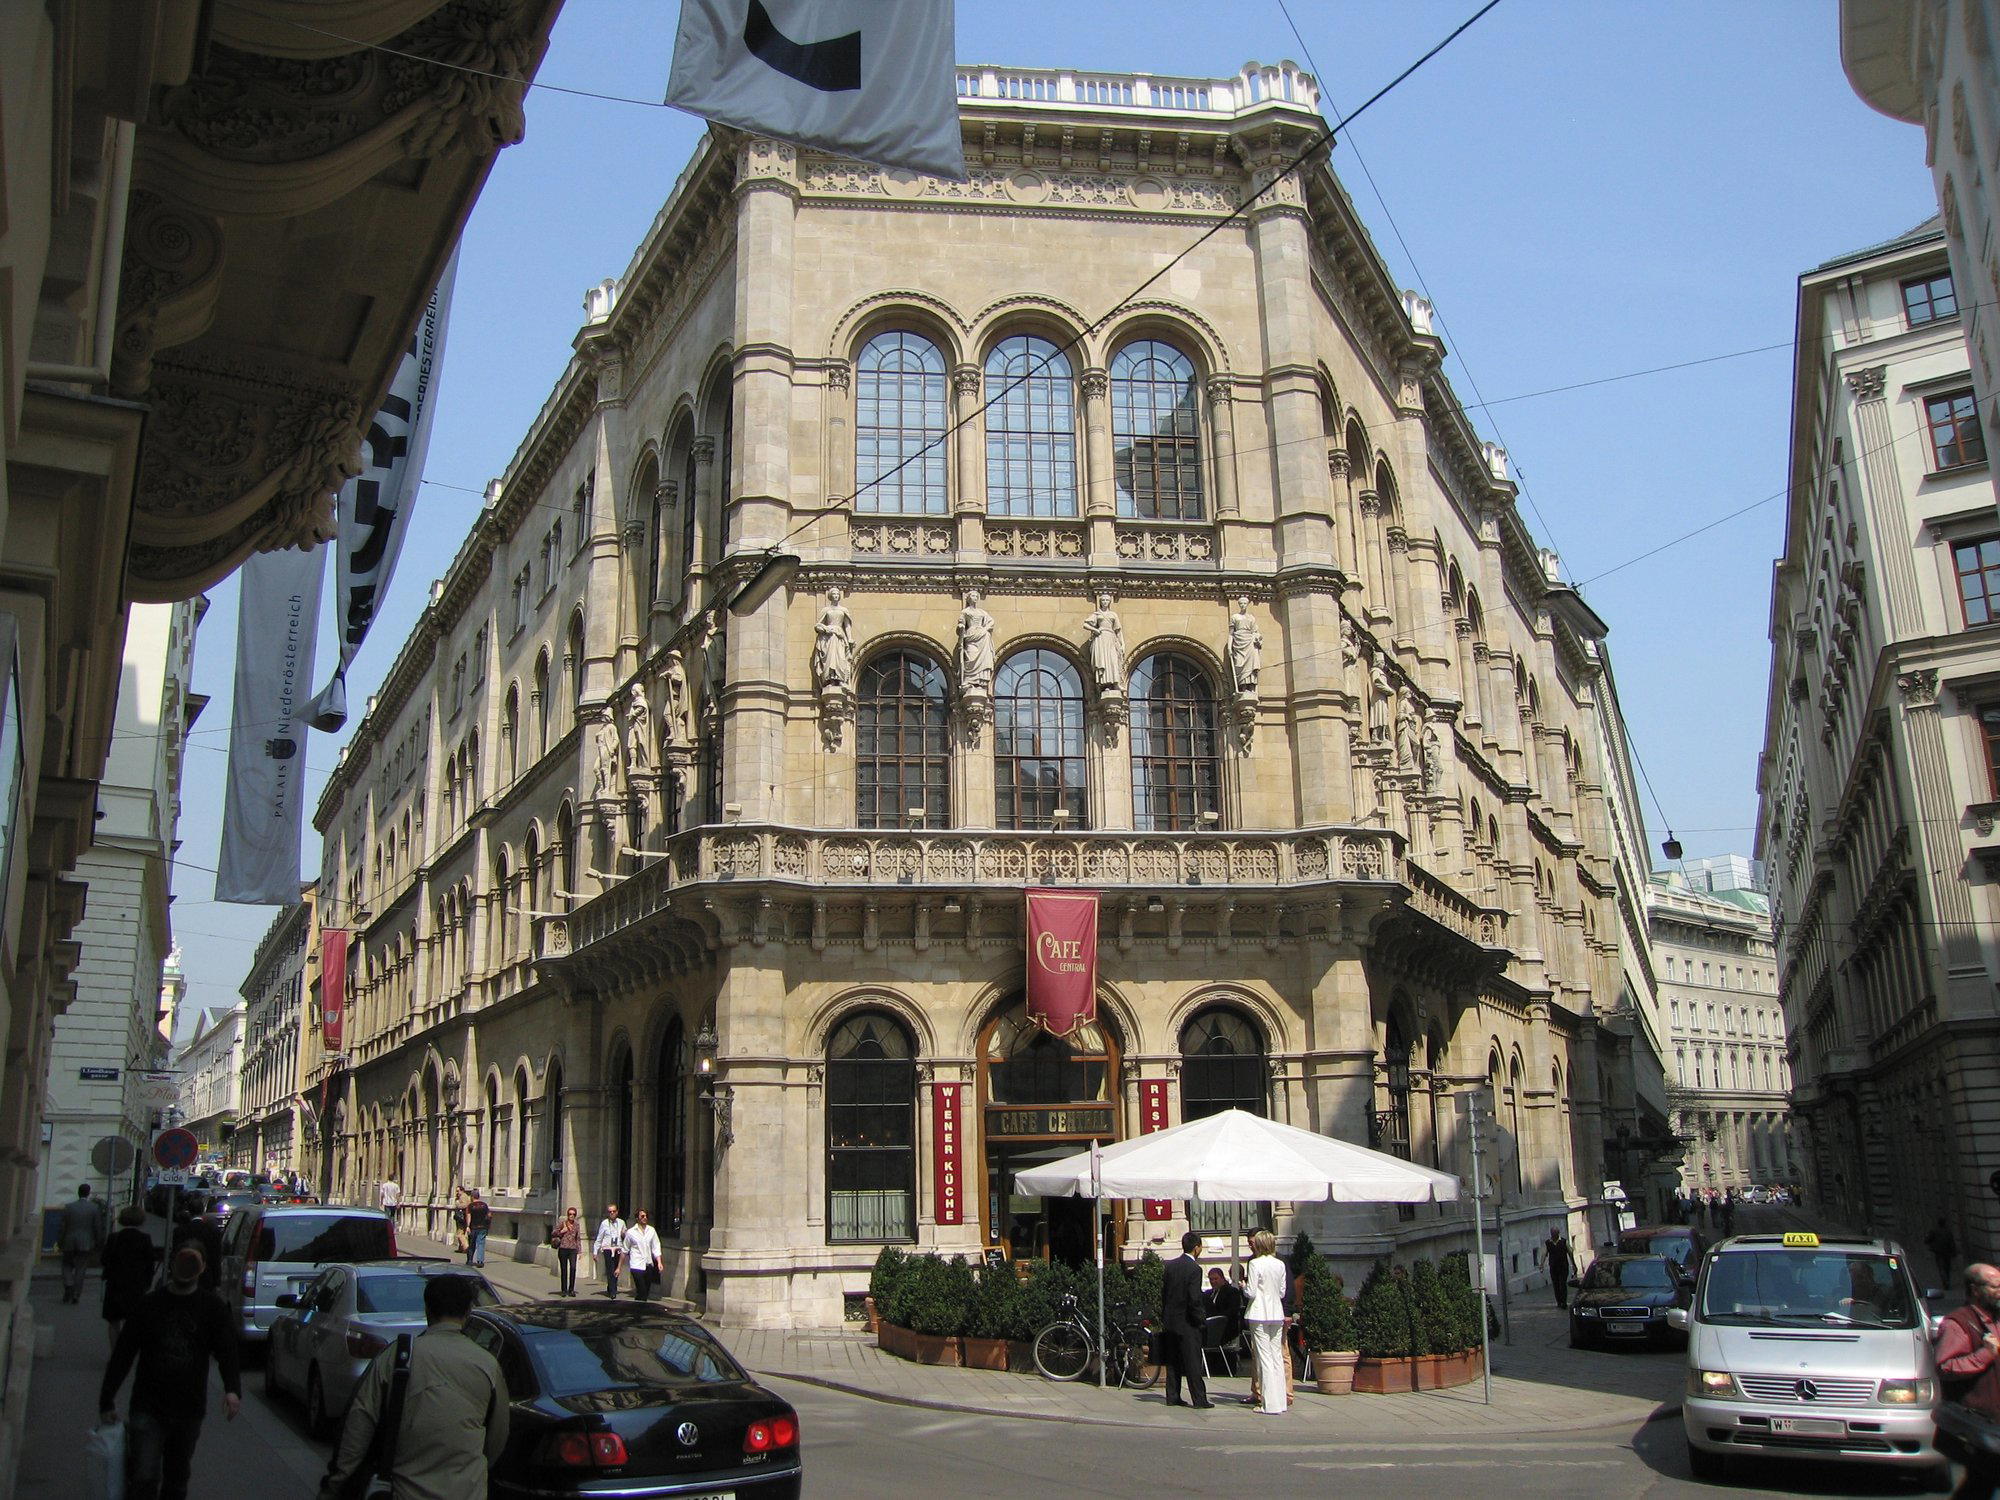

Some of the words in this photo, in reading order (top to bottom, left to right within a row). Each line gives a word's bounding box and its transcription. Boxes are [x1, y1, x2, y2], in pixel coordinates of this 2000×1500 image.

[277, 594, 302, 734] Niederösterreich
[274, 764, 288, 818] PALAIS
[1036, 931, 1082, 975] CAFE
[1059, 962, 1087, 973] CENTRAL
[942, 1086, 954, 1155] WIENER
[1001, 1111, 1038, 1133] CAFE
[1048, 1110, 1109, 1133] CENTRAL
[1150, 1084, 1164, 1216] RESTT
[944, 1160, 954, 1221] KÜCHE
[1788, 1235, 1813, 1243] TAXI
